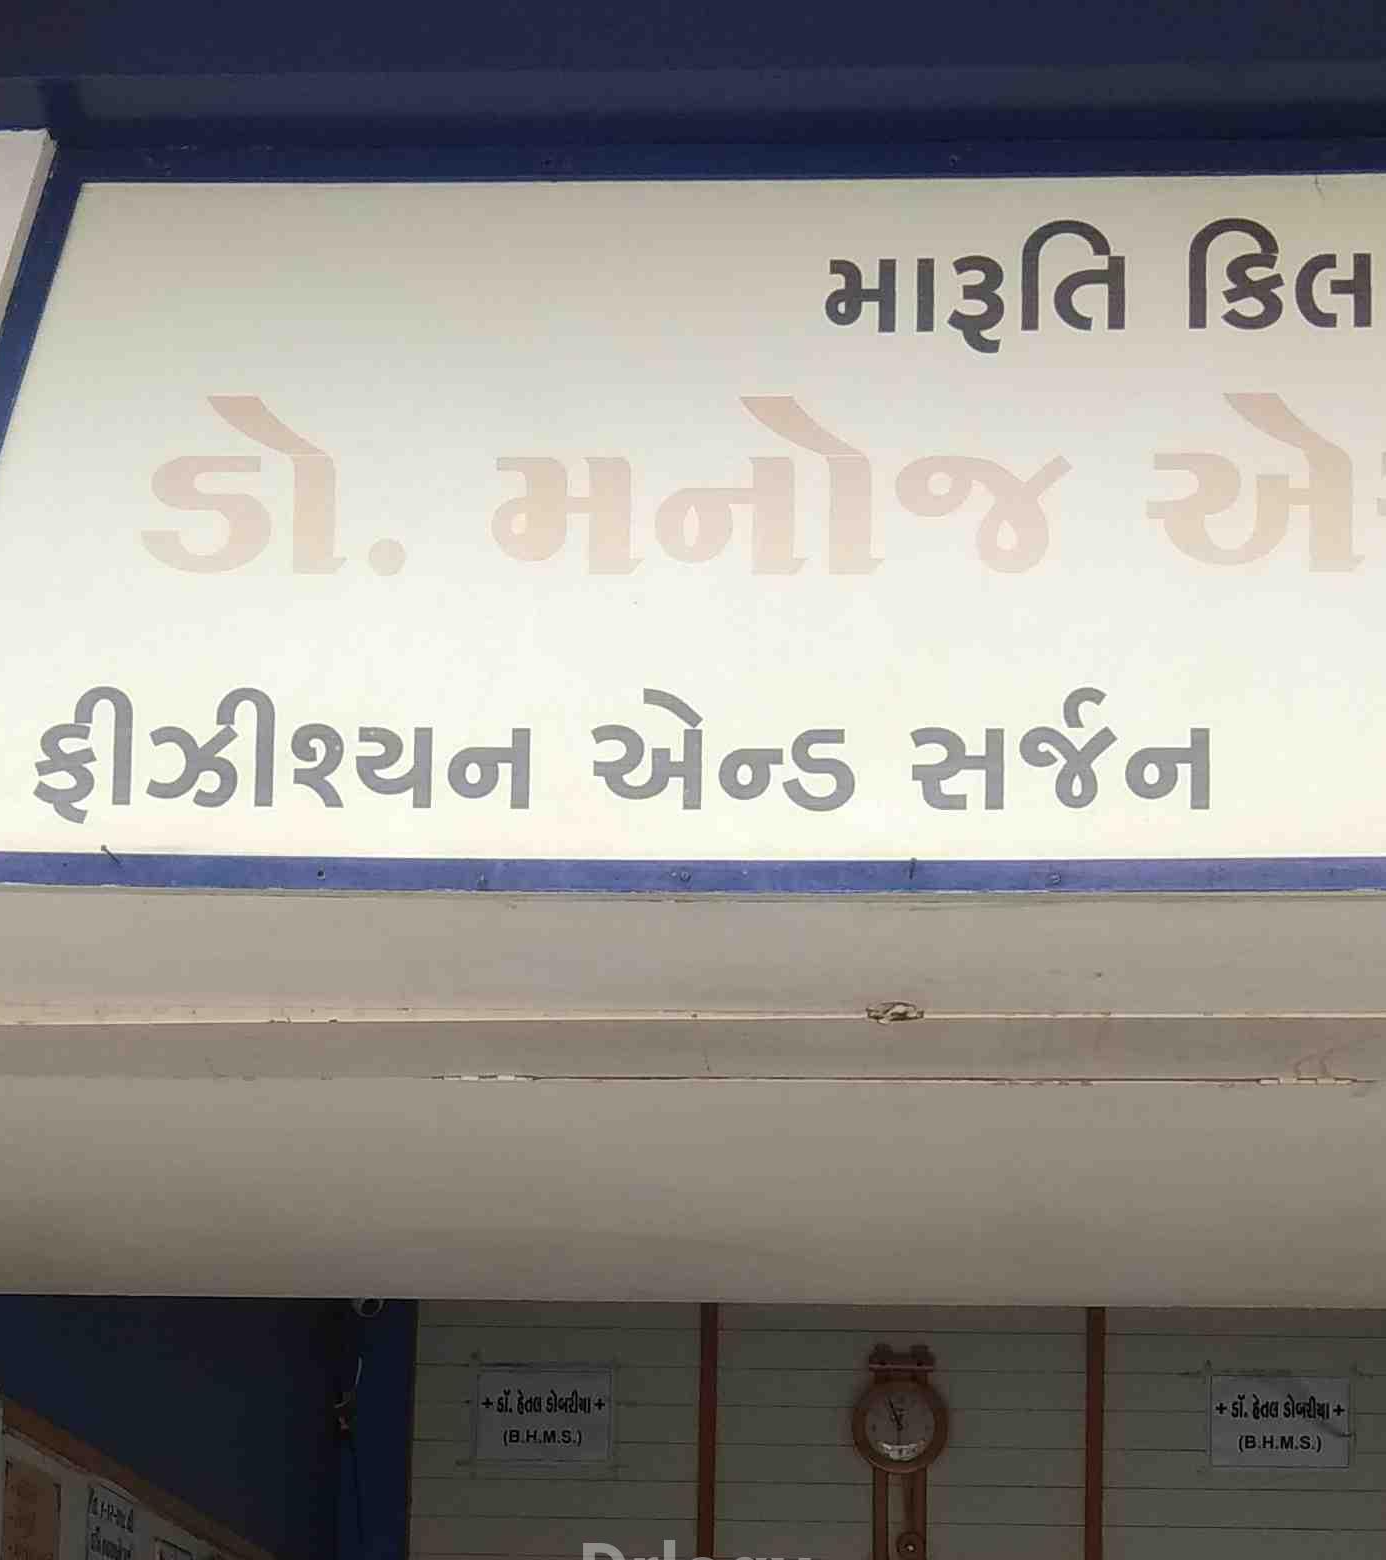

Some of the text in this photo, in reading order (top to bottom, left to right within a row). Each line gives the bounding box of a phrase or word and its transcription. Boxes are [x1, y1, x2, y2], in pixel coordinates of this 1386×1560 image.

[825, 219, 1125, 353] મારૂતિ
[140, 395, 407, 577] ડો.
[491, 395, 1074, 576] મનોજ
[592, 687, 855, 812] એન્ડ
[910, 686, 1210, 812] સર્જન
